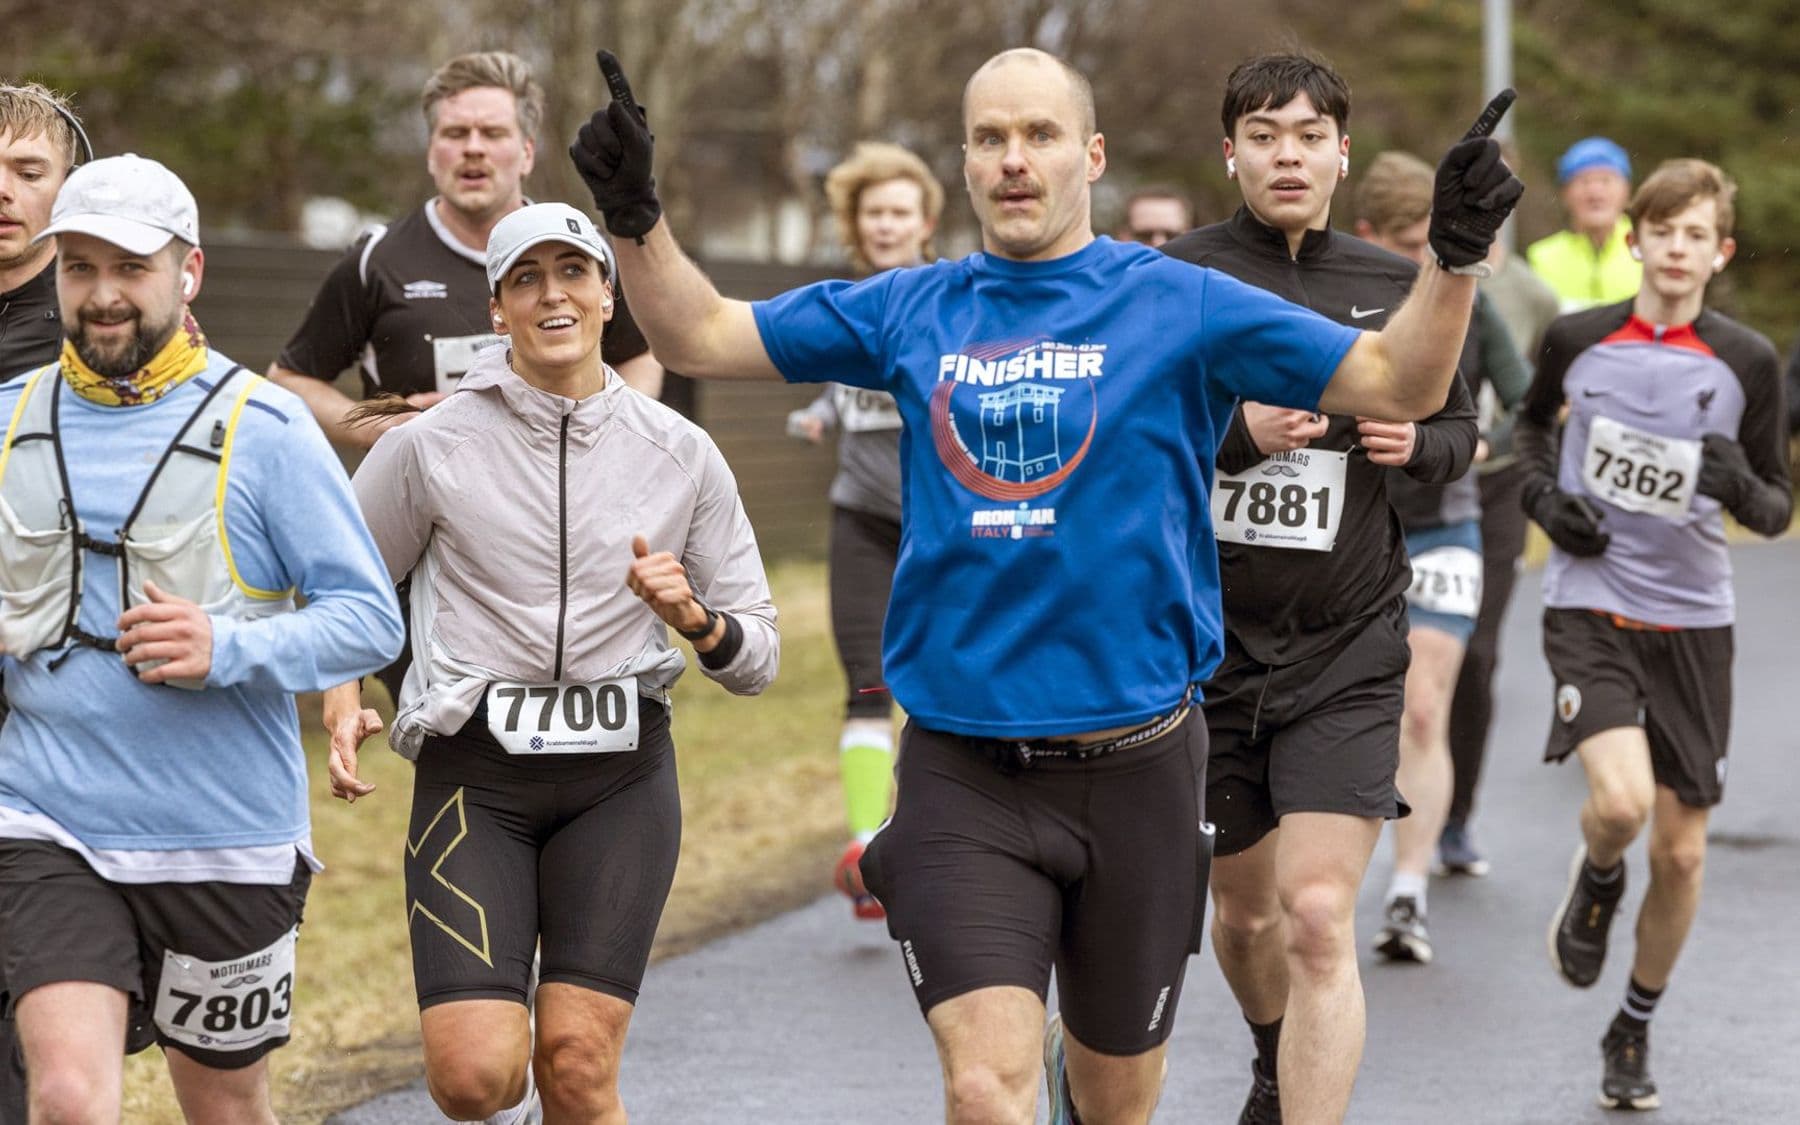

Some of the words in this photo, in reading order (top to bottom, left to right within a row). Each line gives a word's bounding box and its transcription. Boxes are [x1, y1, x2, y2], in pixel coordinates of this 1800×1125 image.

[938, 351, 1105, 387] FINISHER
[1594, 446, 1685, 503] 7362
[1218, 480, 1331, 530] 7881
[971, 527, 1010, 538] ITALY
[496, 683, 628, 733] 7700
[210, 952, 274, 980] MOTTUMARS
[902, 939, 924, 987] FUSION
[168, 971, 293, 1033] 7803
[1148, 985, 1171, 1032] FUSION
